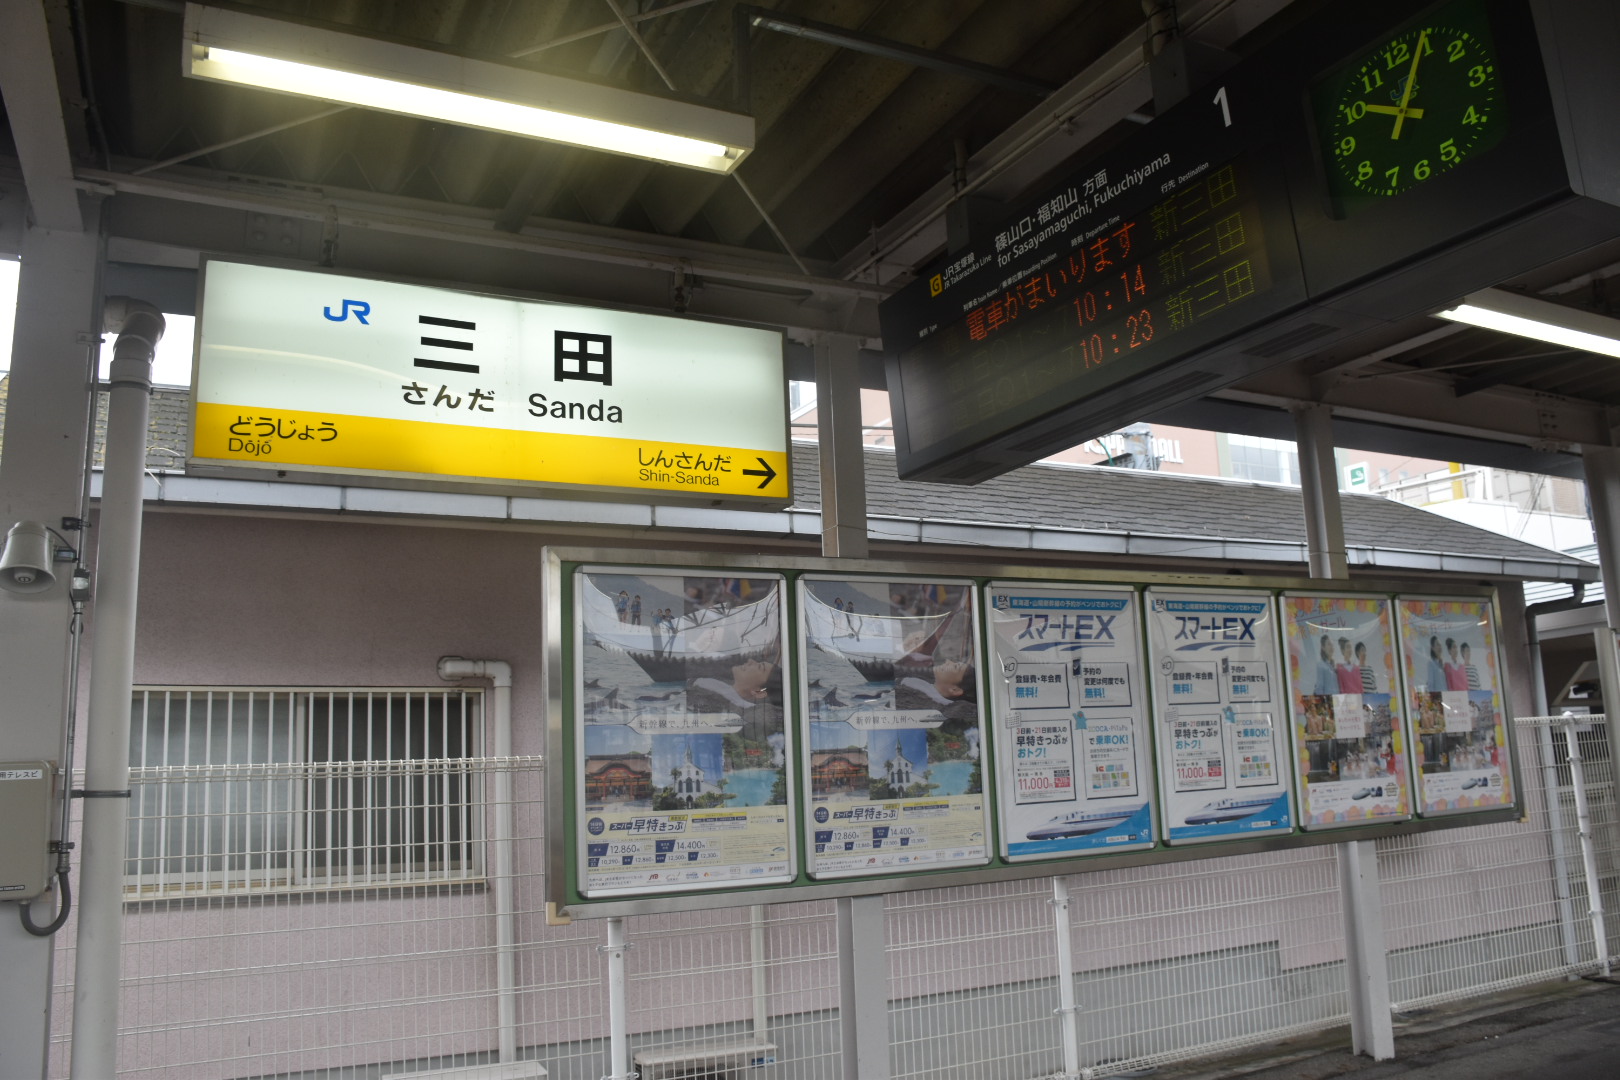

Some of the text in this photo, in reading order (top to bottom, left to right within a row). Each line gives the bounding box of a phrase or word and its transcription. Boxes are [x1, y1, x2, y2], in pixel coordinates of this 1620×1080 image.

[1384, 43, 1411, 70] 12
[1423, 36, 1435, 57] 1
[1447, 40, 1467, 63] 2
[1361, 68, 1384, 94] 11
[1468, 65, 1487, 88] 3
[1212, 86, 1232, 127] 1
[1344, 100, 1368, 126] 10
[1462, 105, 1480, 125] 4
[1340, 136, 1357, 156] 9
[1440, 138, 1458, 162] 5
[1082, 168, 1109, 197] 方面
[1178, 161, 1209, 184] Destination
[1358, 160, 1374, 181] 8
[1385, 166, 1400, 187] 7
[1414, 160, 1431, 180] 6
[997, 153, 1171, 268] for Sasayamaguchi, Fukuchiyama
[1085, 222, 1108, 239] Departure
[1108, 215, 1120, 227] Time
[951, 262, 979, 286] Takarazuka
[979, 254, 992, 267] Line
[966, 221, 1136, 341] 電車がまいります
[323, 299, 371, 325] JR
[401, 382, 624, 424] さんだ Sanda
[228, 415, 338, 443] どうじょう
[638, 447, 733, 474] しんさんだ
[638, 469, 720, 488] Shin-Sanda
[1018, 614, 1116, 640] スマートEX
[1174, 616, 1256, 640] スマートEX
